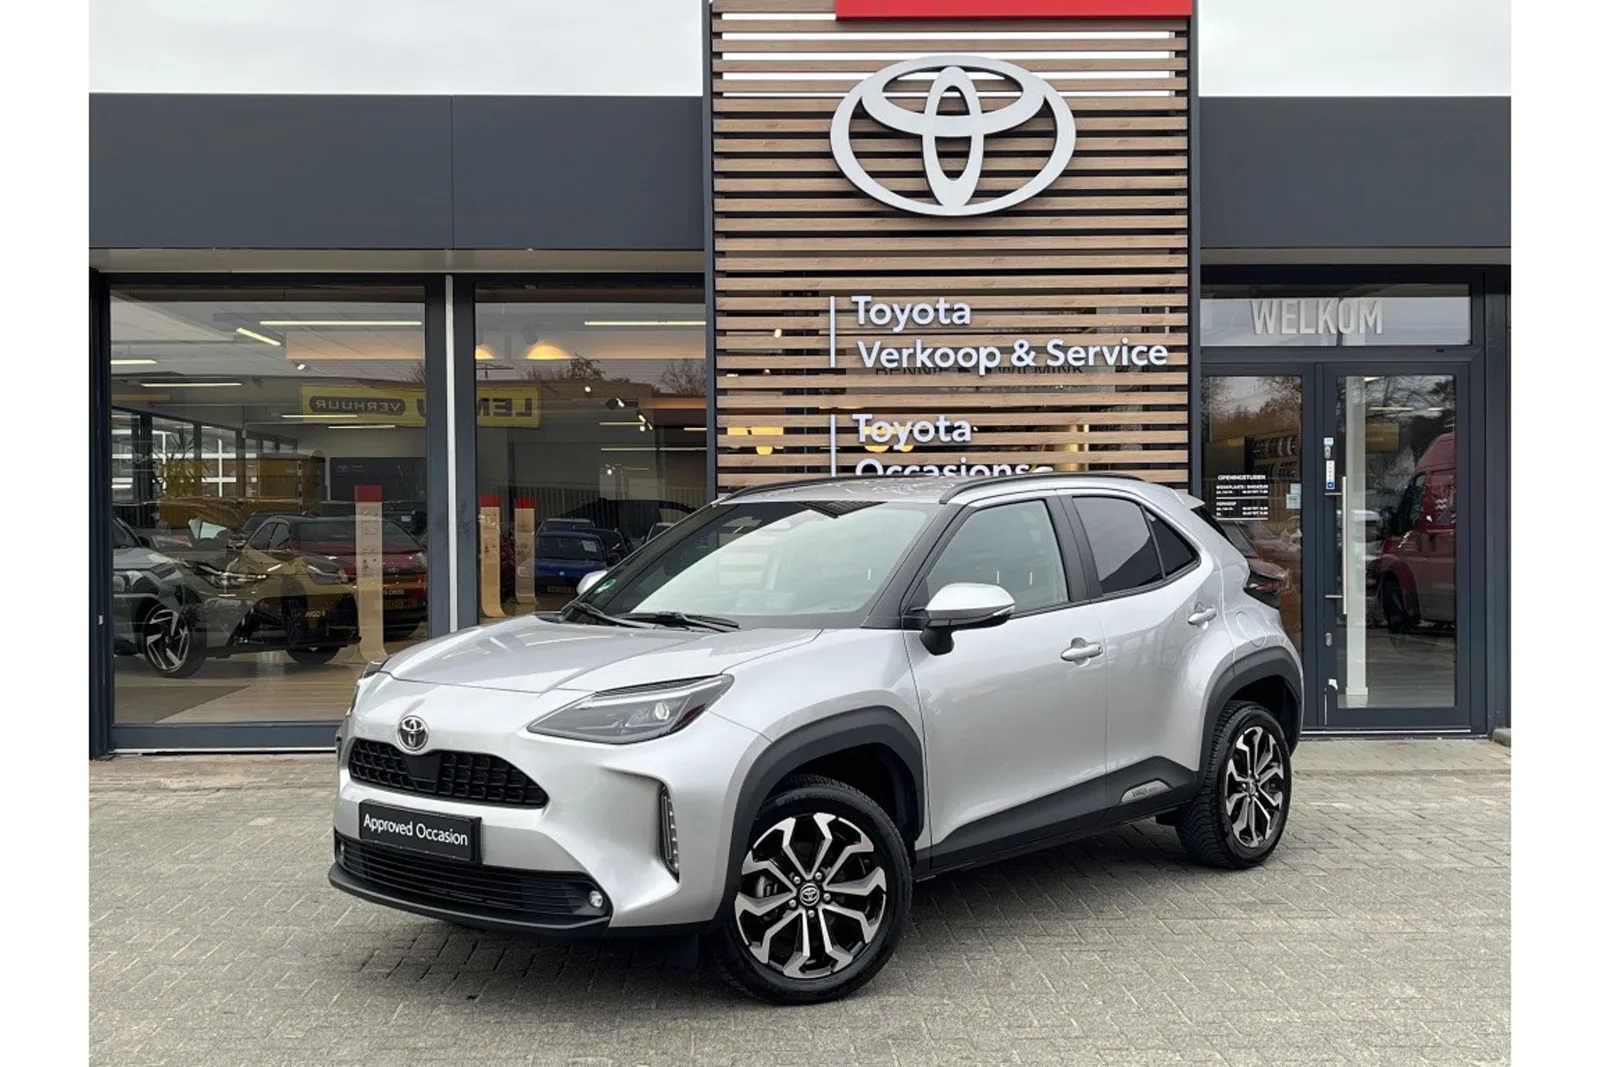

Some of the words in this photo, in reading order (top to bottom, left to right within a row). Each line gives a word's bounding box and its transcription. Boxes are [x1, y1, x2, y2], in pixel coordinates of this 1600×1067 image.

[850, 295, 972, 333] Toyota
[1250, 299, 1383, 335] WELKOM
[857, 338, 1001, 376] Verkoop
[1010, 338, 1037, 367] &
[1046, 336, 1169, 367] Service
[851, 413, 972, 451] Toyota
[363, 813, 413, 836] Approved
[416, 823, 468, 846] Occasion
